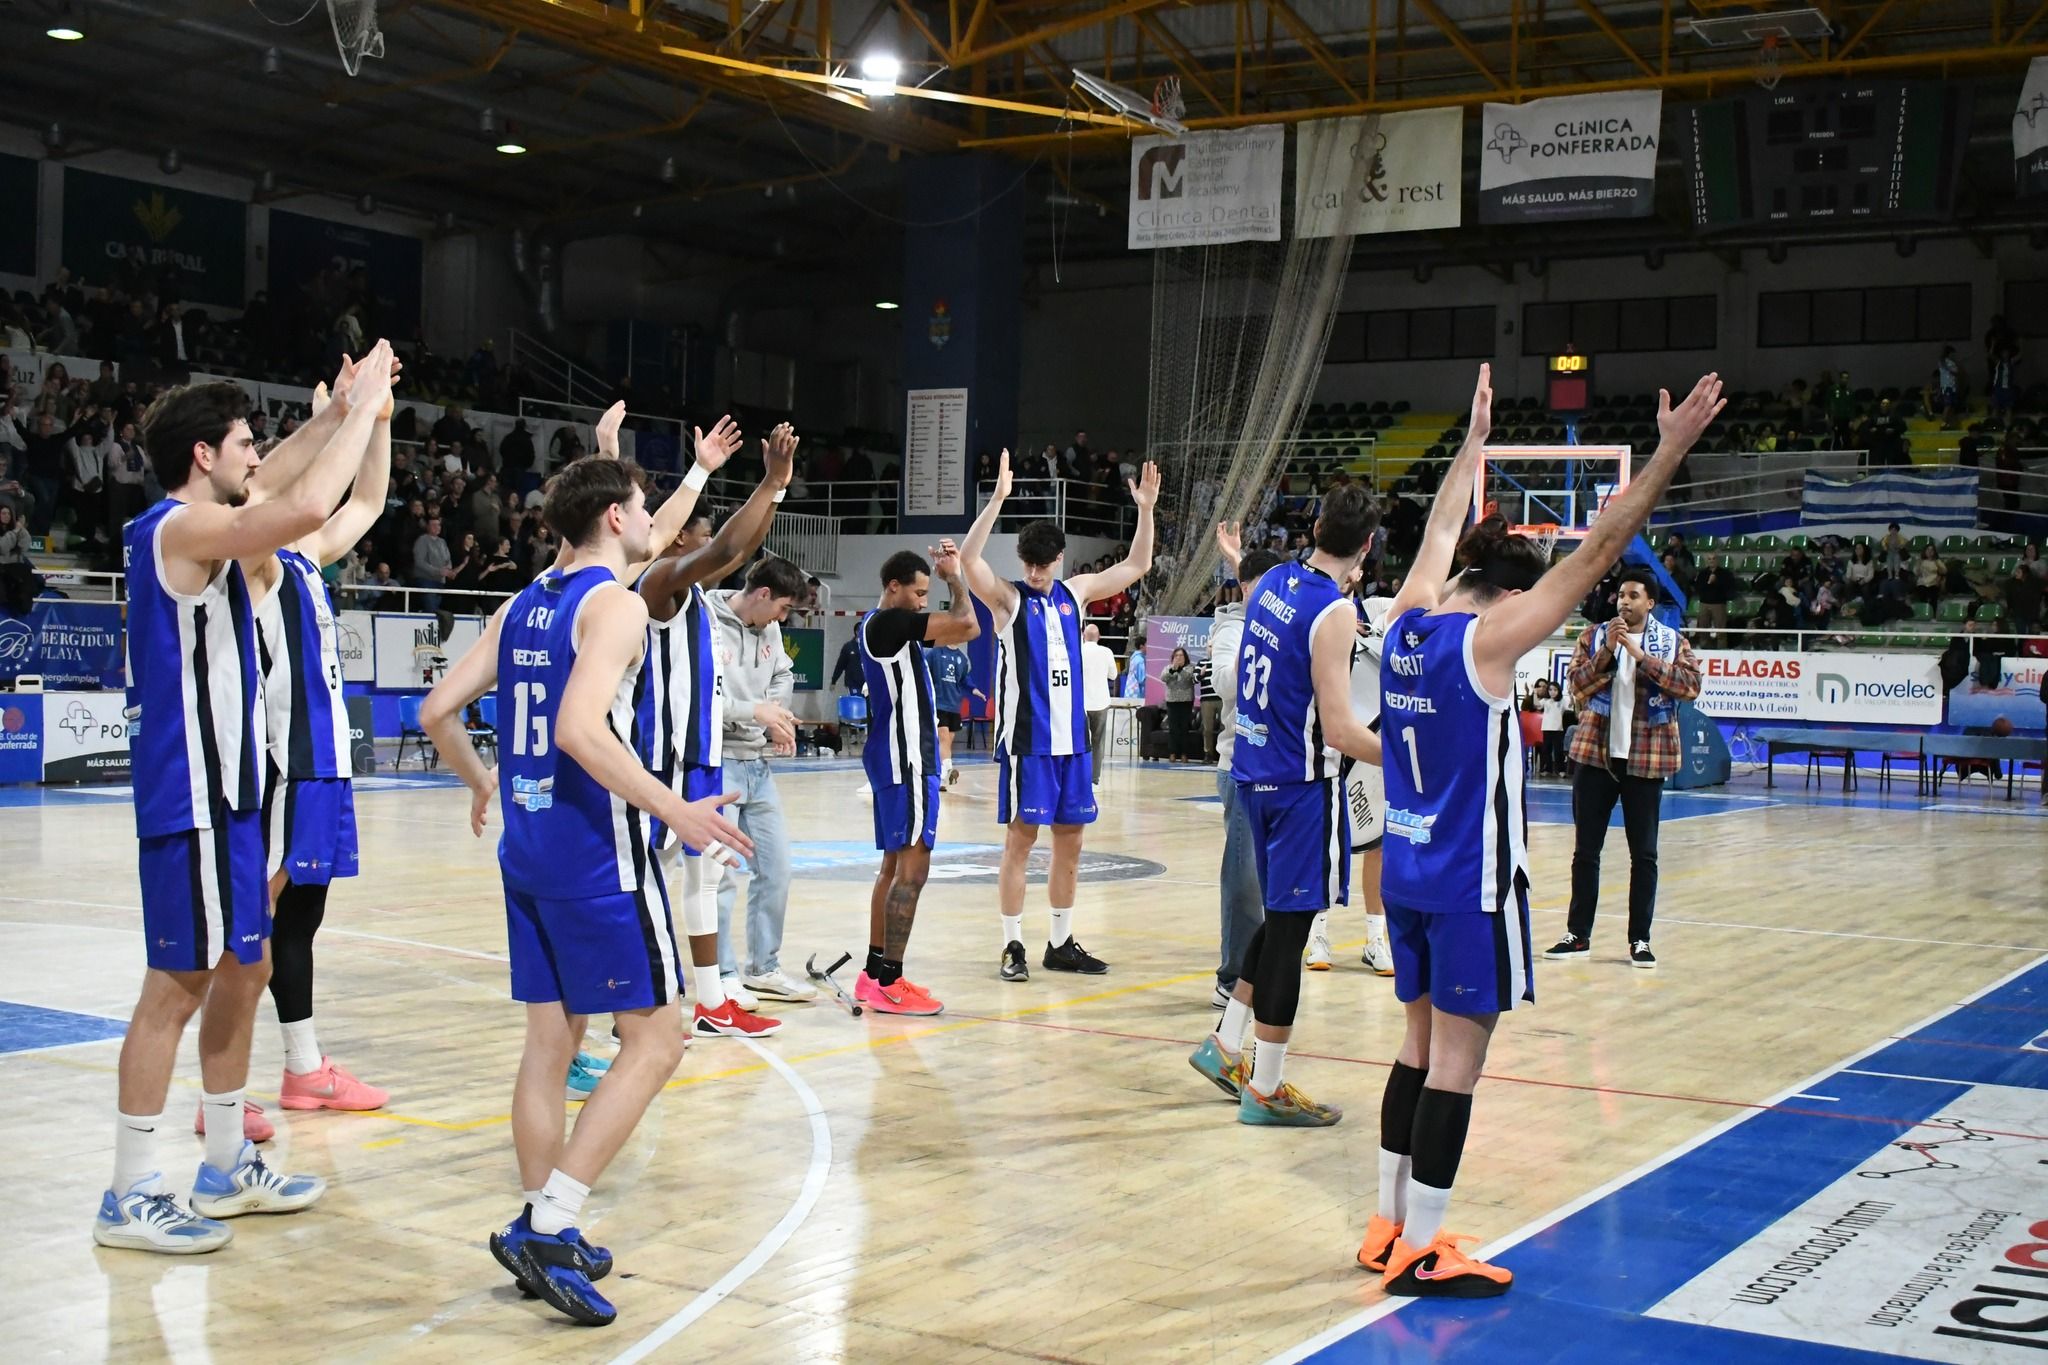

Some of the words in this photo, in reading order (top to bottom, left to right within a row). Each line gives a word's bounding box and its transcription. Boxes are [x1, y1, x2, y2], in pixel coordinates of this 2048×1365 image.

[1774, 96, 1795, 105] LOCAL
[1530, 134, 1656, 158] PONFERRADA
[1399, 181, 1444, 203] rest
[1502, 193, 1526, 206] MÁS
[1569, 188, 1593, 201] MÁS
[1596, 188, 1638, 200] BIERZO
[1212, 203, 1276, 223] Dental
[42, 632, 115, 647] BERGIDUM
[40, 646, 82, 661] PLAYA
[1242, 644, 1272, 711] 33
[1708, 658, 1801, 679] ELAGAS
[42, 672, 100, 685] bergidumplaya
[1051, 669, 1069, 687] 56
[1705, 689, 1799, 699] www.elagas.es
[1855, 679, 1935, 699] novelec
[1385, 690, 1437, 714] REDYTEL
[1767, 703, 1798, 714] (León)
[29, 733, 38, 741] de
[87, 758, 104, 767] MÁS
[1401, 726, 1423, 794] 1
[1348, 780, 1373, 830] JINBAO
[242, 933, 259, 943] vive
[1945, 1208, 2022, 1254] Tecnologías
[1729, 1200, 1897, 1305] www.proconsi.com
[1933, 1252, 1976, 1264] de
[1923, 1262, 1967, 1273] la
